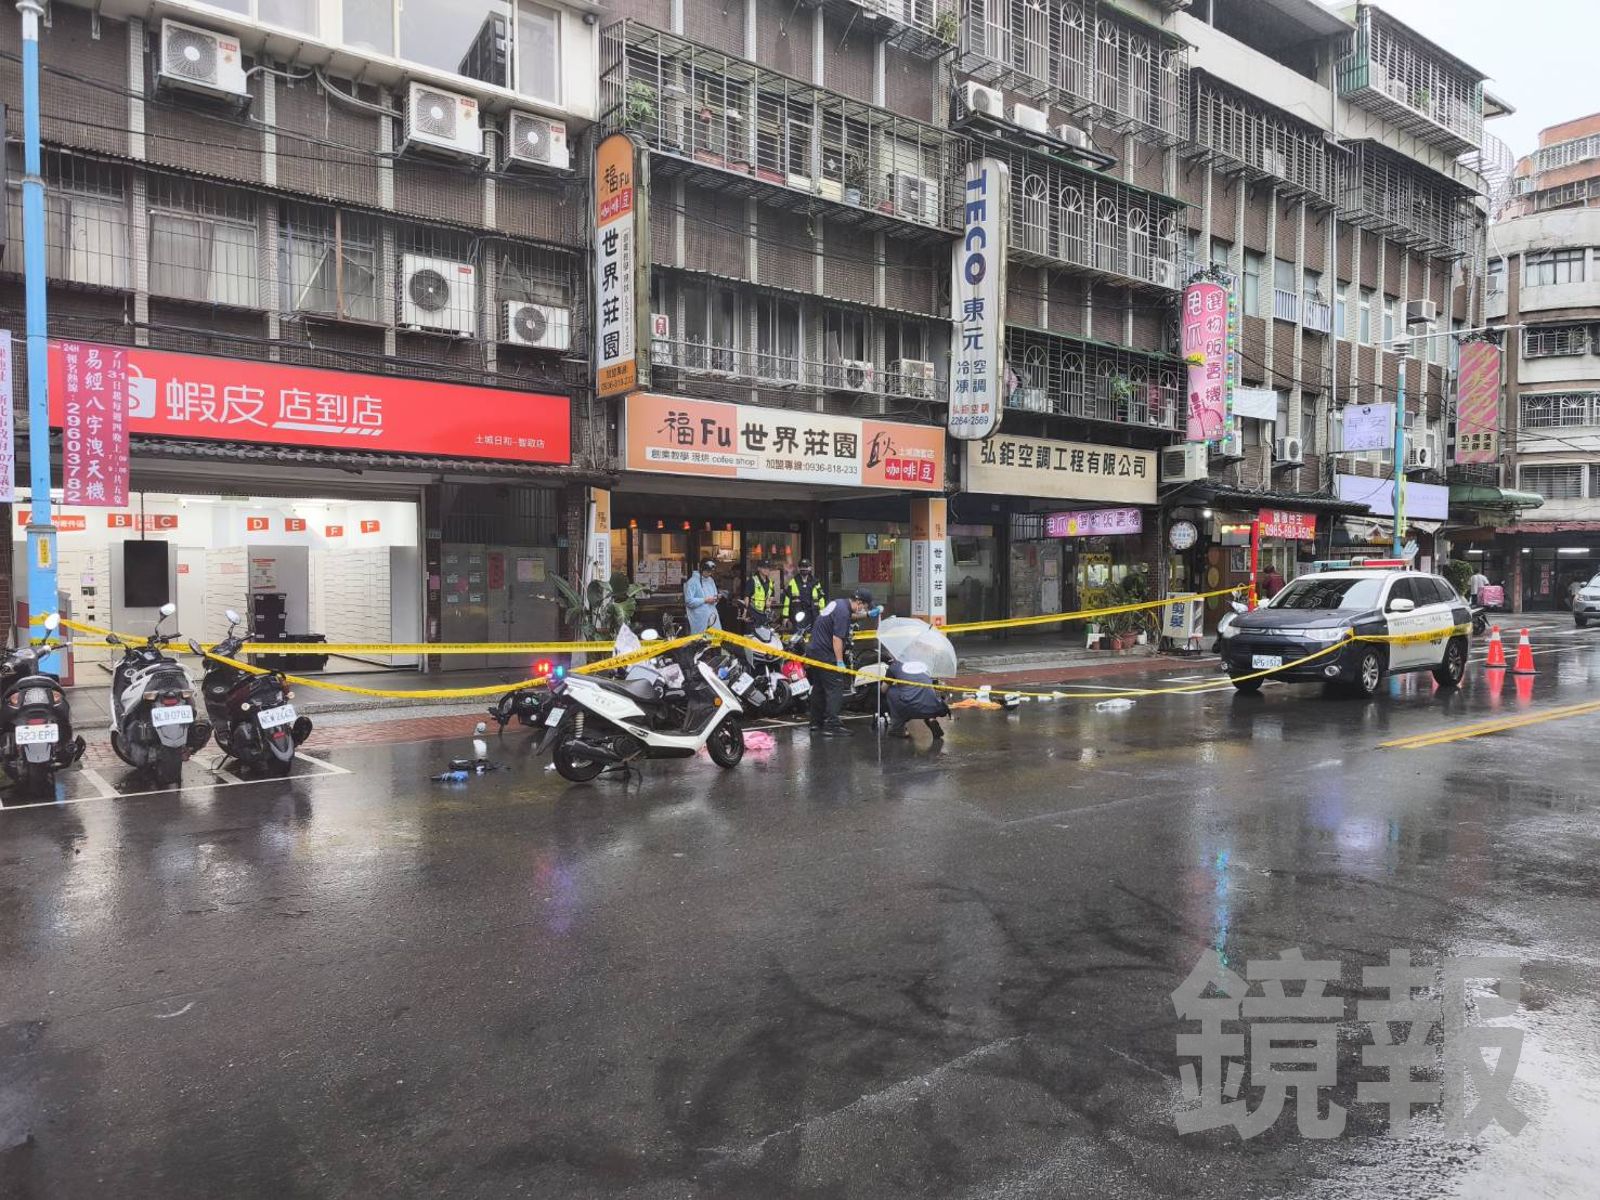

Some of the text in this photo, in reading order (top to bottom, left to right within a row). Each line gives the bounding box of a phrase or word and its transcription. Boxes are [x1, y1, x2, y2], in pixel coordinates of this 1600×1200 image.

[965, 169, 987, 285] TECO
[602, 228, 620, 361] 世界莊園
[963, 297, 985, 352] 東元
[1206, 291, 1223, 403] 選物販賣機
[166, 377, 383, 428] 蝦皮 店到店
[85, 349, 105, 501] 易經八字洩天機
[741, 422, 857, 459] 世界莊園
[736, 457, 756, 467] shop
[886, 461, 935, 482] 咖啡豆
[980, 440, 1146, 478] 弘鉅空調工程有限公司
[115, 515, 125, 525] B
[160, 516, 171, 527] C
[253, 519, 262, 529] D
[291, 520, 299, 530] E
[331, 528, 338, 536] F
[366, 522, 373, 532] F
[934, 547, 943, 607] 世界莊園
